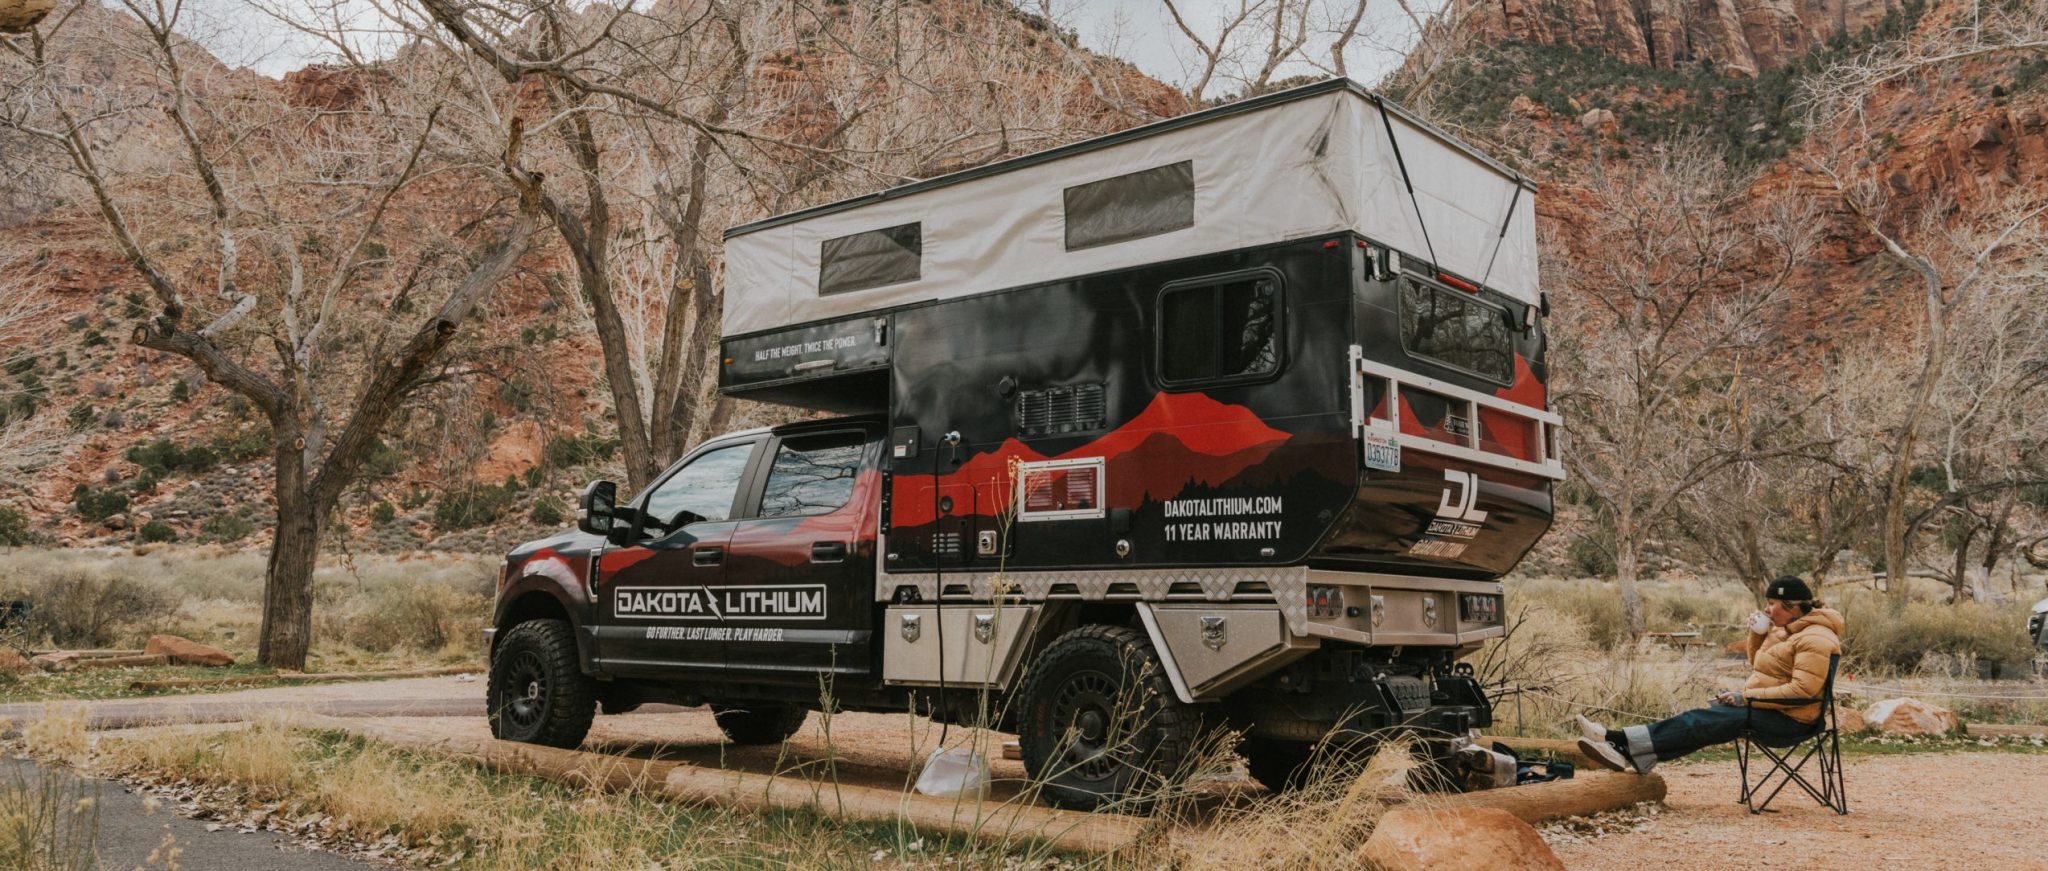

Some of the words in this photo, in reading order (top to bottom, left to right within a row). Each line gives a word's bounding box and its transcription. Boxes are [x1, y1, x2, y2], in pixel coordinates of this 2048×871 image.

[755, 351, 770, 361] HALF
[770, 349, 781, 359] THE
[782, 344, 803, 357] WEIGHT.
[804, 341, 822, 354] TWICE
[823, 339, 834, 351] THE
[834, 336, 857, 348] POWER.
[1164, 496, 1282, 518] DAKOTALITHIUM.COM
[1164, 524, 1176, 541] 11
[1179, 523, 1210, 541] YEAR
[1213, 521, 1282, 540] WARRANTY
[618, 591, 704, 612] DAKOTA
[725, 591, 821, 613] LITHIUM
[646, 626, 656, 639] GO
[655, 627, 685, 640] FURTHER.
[686, 627, 703, 640] LAST
[703, 627, 733, 641] LONGER.
[733, 628, 752, 641] PLAY
[752, 628, 784, 642] HARDER.
